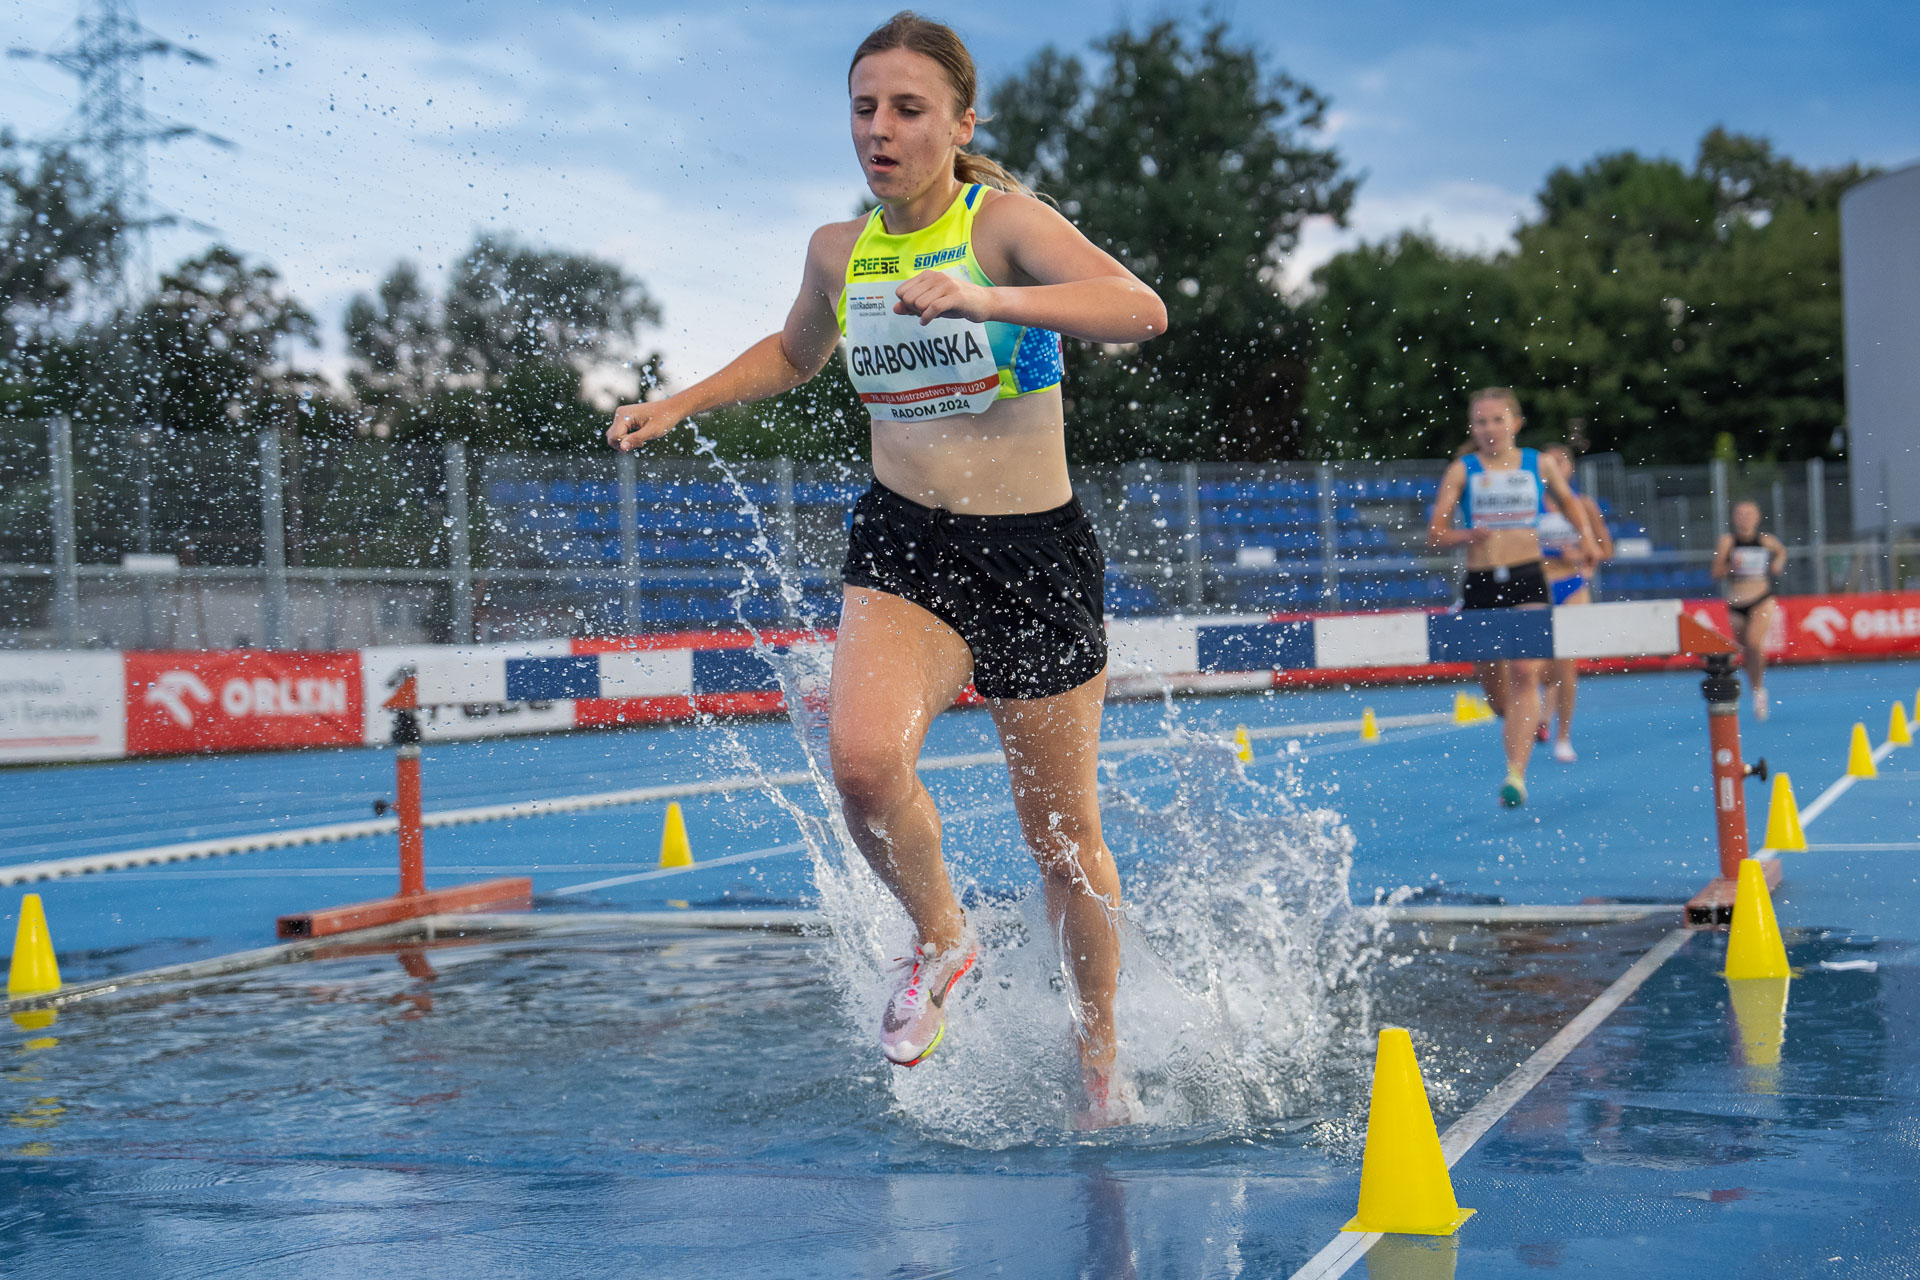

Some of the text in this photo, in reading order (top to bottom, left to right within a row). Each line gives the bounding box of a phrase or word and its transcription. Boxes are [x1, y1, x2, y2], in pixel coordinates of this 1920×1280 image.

[851, 331, 984, 377] GRABOWSKA
[896, 387, 945, 402] Mistrzostwa
[946, 385, 967, 395] Polski
[967, 381, 986, 393] U20
[891, 399, 971, 418] RADOM 2024
[1852, 608, 1920, 640] ORLE
[221, 677, 348, 717] ORLEN
